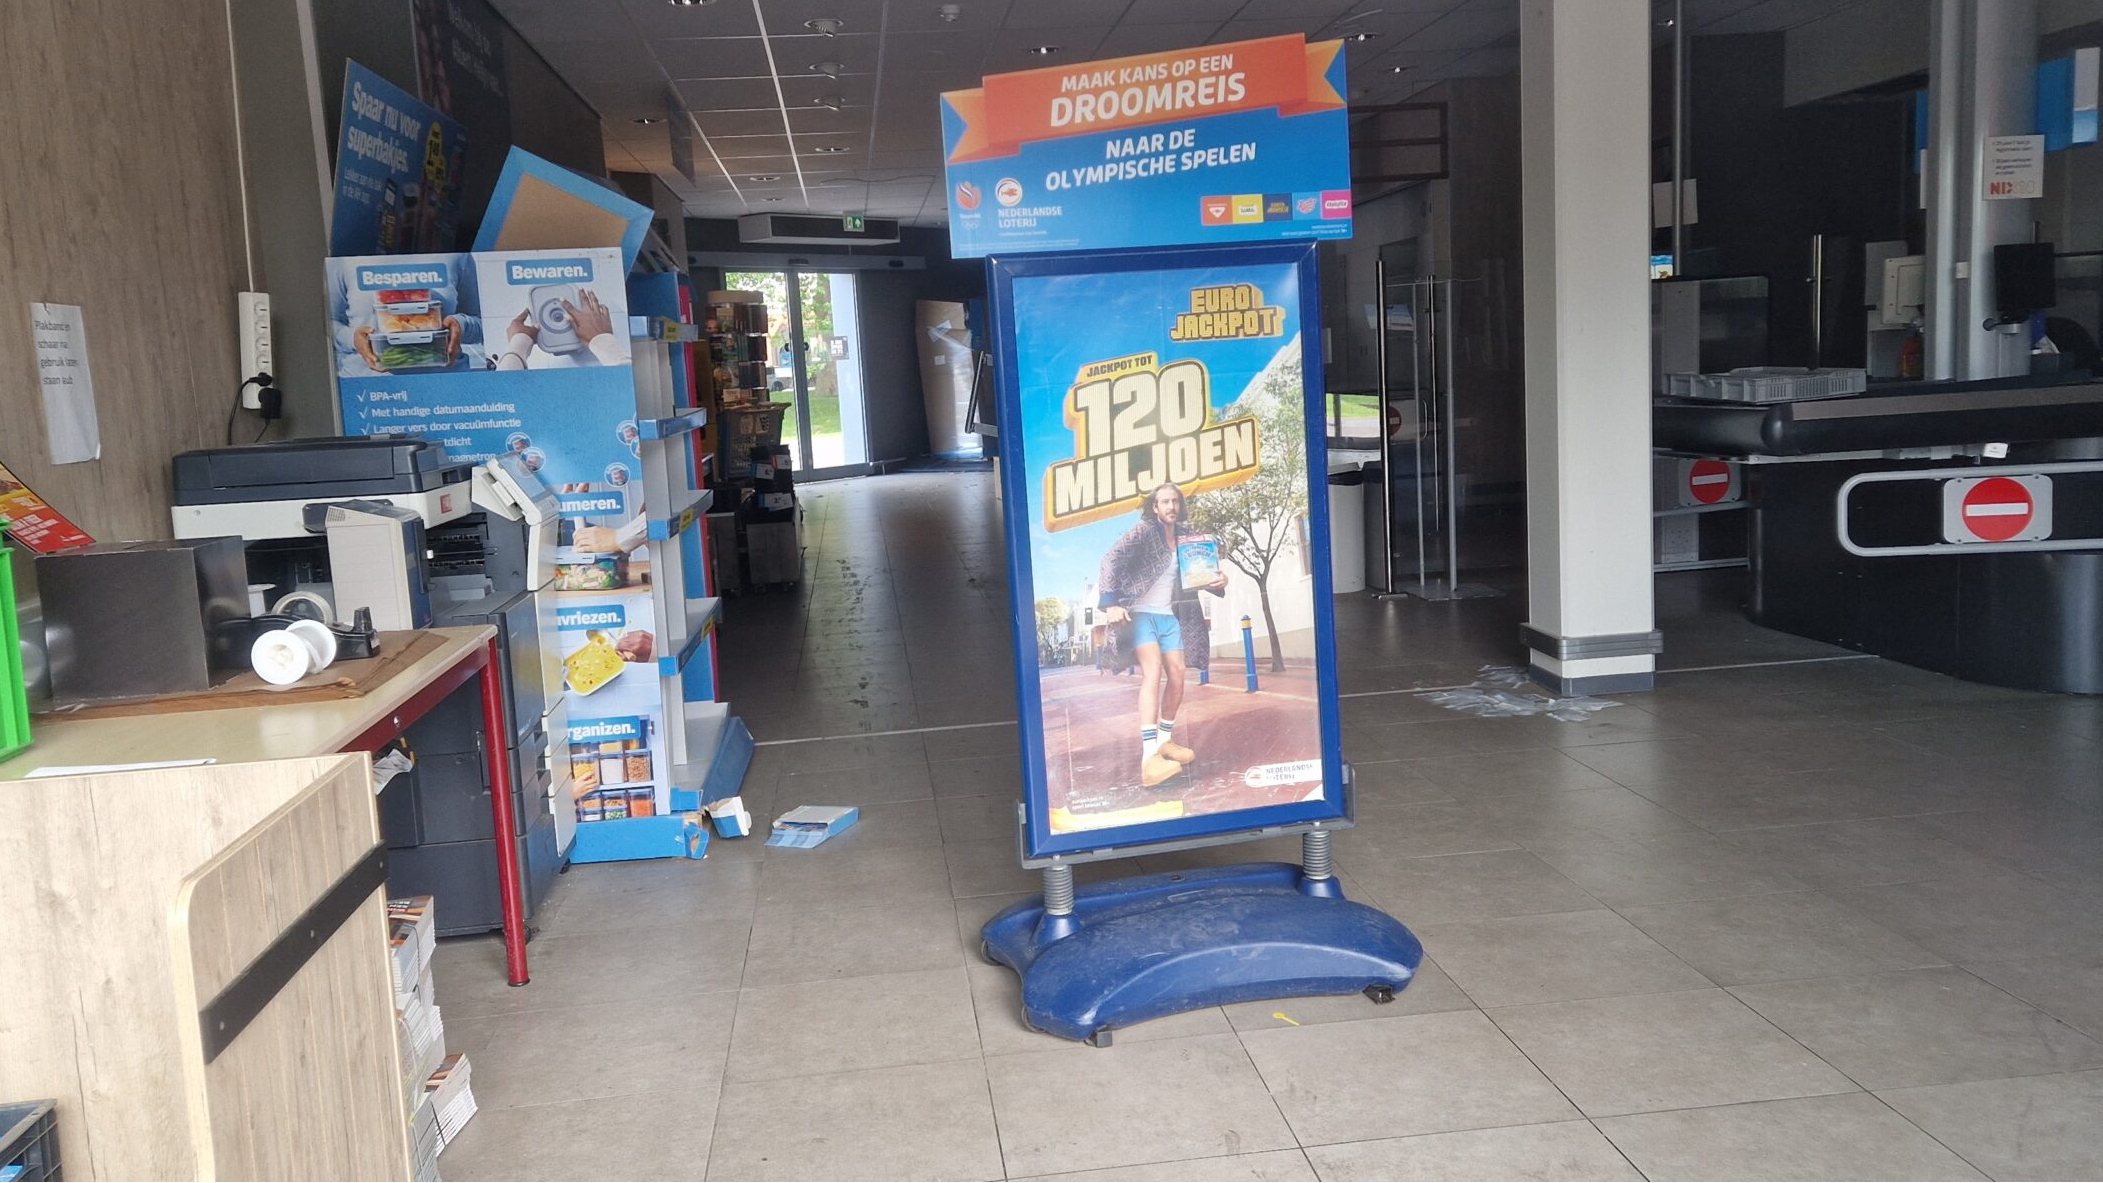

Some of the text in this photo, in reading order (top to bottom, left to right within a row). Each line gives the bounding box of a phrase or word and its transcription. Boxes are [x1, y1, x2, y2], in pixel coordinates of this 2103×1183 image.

[1061, 54, 1233, 92] MAAK KANS OP EEN
[1050, 72, 1246, 127] DROOMREIS
[351, 81, 421, 142] Spaar nu voor
[347, 125, 409, 174] superbakjes.
[1105, 128, 1196, 160] NAAR DE
[1045, 142, 1256, 191] OLYMPISCHE SPELEN
[998, 206, 1063, 218] NEDERLANDSE
[998, 217, 1037, 229] LOTERIJ
[362, 269, 443, 287] Besparen.
[511, 264, 588, 280] Bewaren.
[1190, 284, 1252, 313] EURO
[1169, 307, 1276, 340] JACKPOT
[1086, 355, 1153, 378] JACKPOT TOT
[369, 390, 408, 402] BPA-vrij
[371, 402, 516, 417] Met handige datumaanduiding
[1076, 363, 1204, 458] 120
[373, 418, 522, 435] Langer vers door vacuümfunctie
[443, 436, 472, 447] tdicht
[1055, 421, 1256, 516] MILJOEN
[560, 498, 621, 512] umeren.
[567, 722, 636, 741] rganizen.
